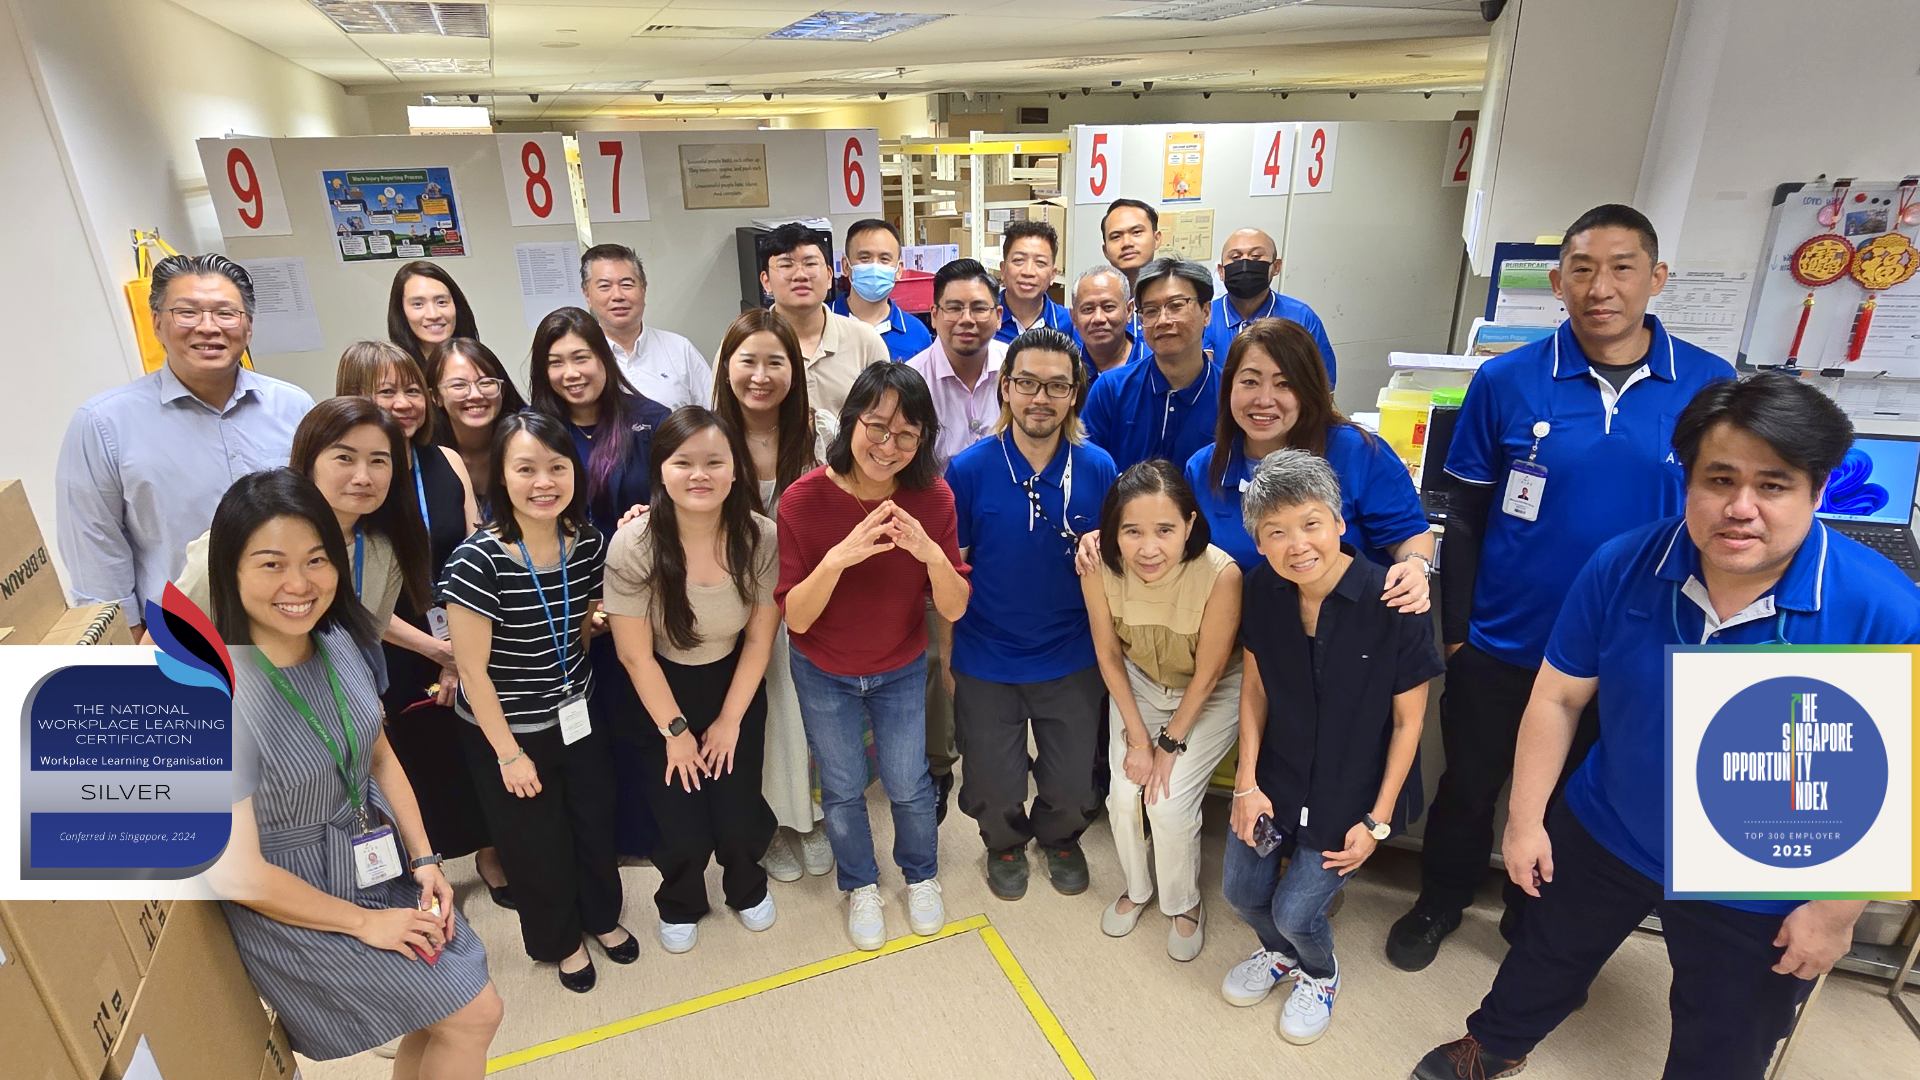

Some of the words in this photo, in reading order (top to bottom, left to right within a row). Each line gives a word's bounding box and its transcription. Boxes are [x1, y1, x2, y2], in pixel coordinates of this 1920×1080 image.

[522, 142, 553, 218] 8
[600, 142, 622, 213] 7
[844, 138, 864, 206] 6
[1090, 134, 1107, 196] 5
[1264, 131, 1281, 188] 4
[1309, 129, 1325, 187] 3
[1453, 127, 1473, 181] 2
[227, 148, 263, 228] 9
